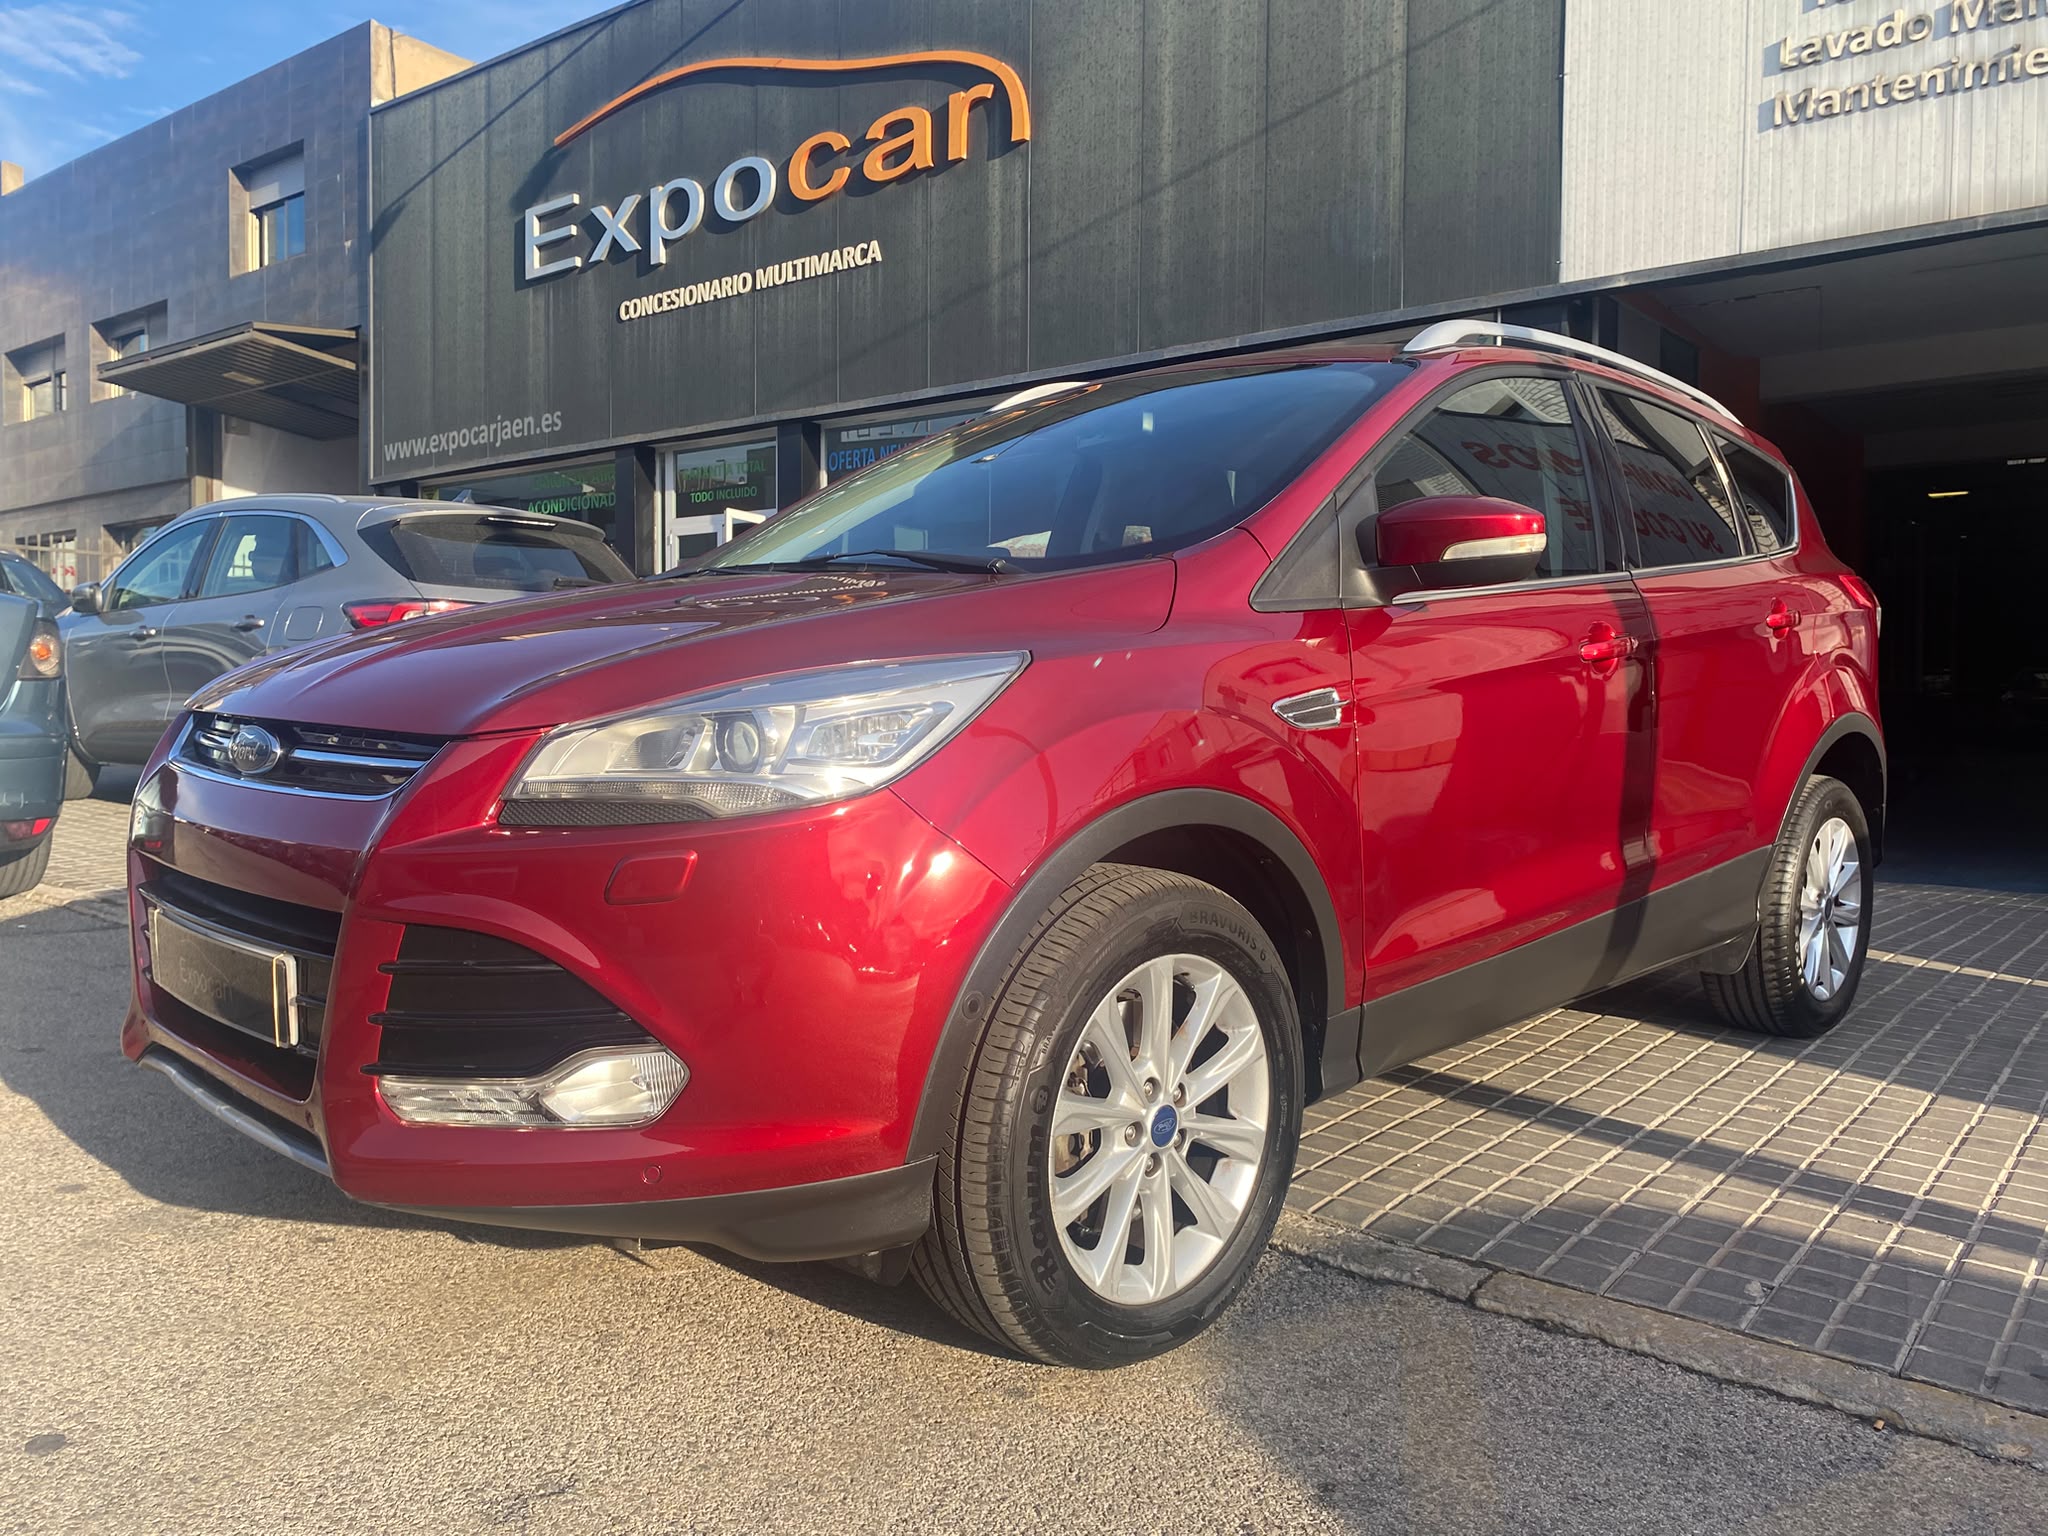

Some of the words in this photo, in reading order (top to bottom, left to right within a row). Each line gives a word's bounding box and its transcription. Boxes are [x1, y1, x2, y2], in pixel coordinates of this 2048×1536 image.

[1780, 9, 1935, 69] Lavado
[1773, 43, 2048, 127] Mantenimie
[525, 83, 995, 281] Expocar
[619, 271, 753, 321] CONCESIONARIO
[755, 239, 883, 291] MULTIMARCA
[384, 410, 562, 462] www.expocarjaen.es
[828, 447, 876, 472] OFERTA
[528, 492, 616, 515] ACONDICIONAD
[690, 491, 713, 504] TODO
[716, 486, 758, 501] INCLUIDO
[1189, 911, 1257, 950] BRAVURIS
